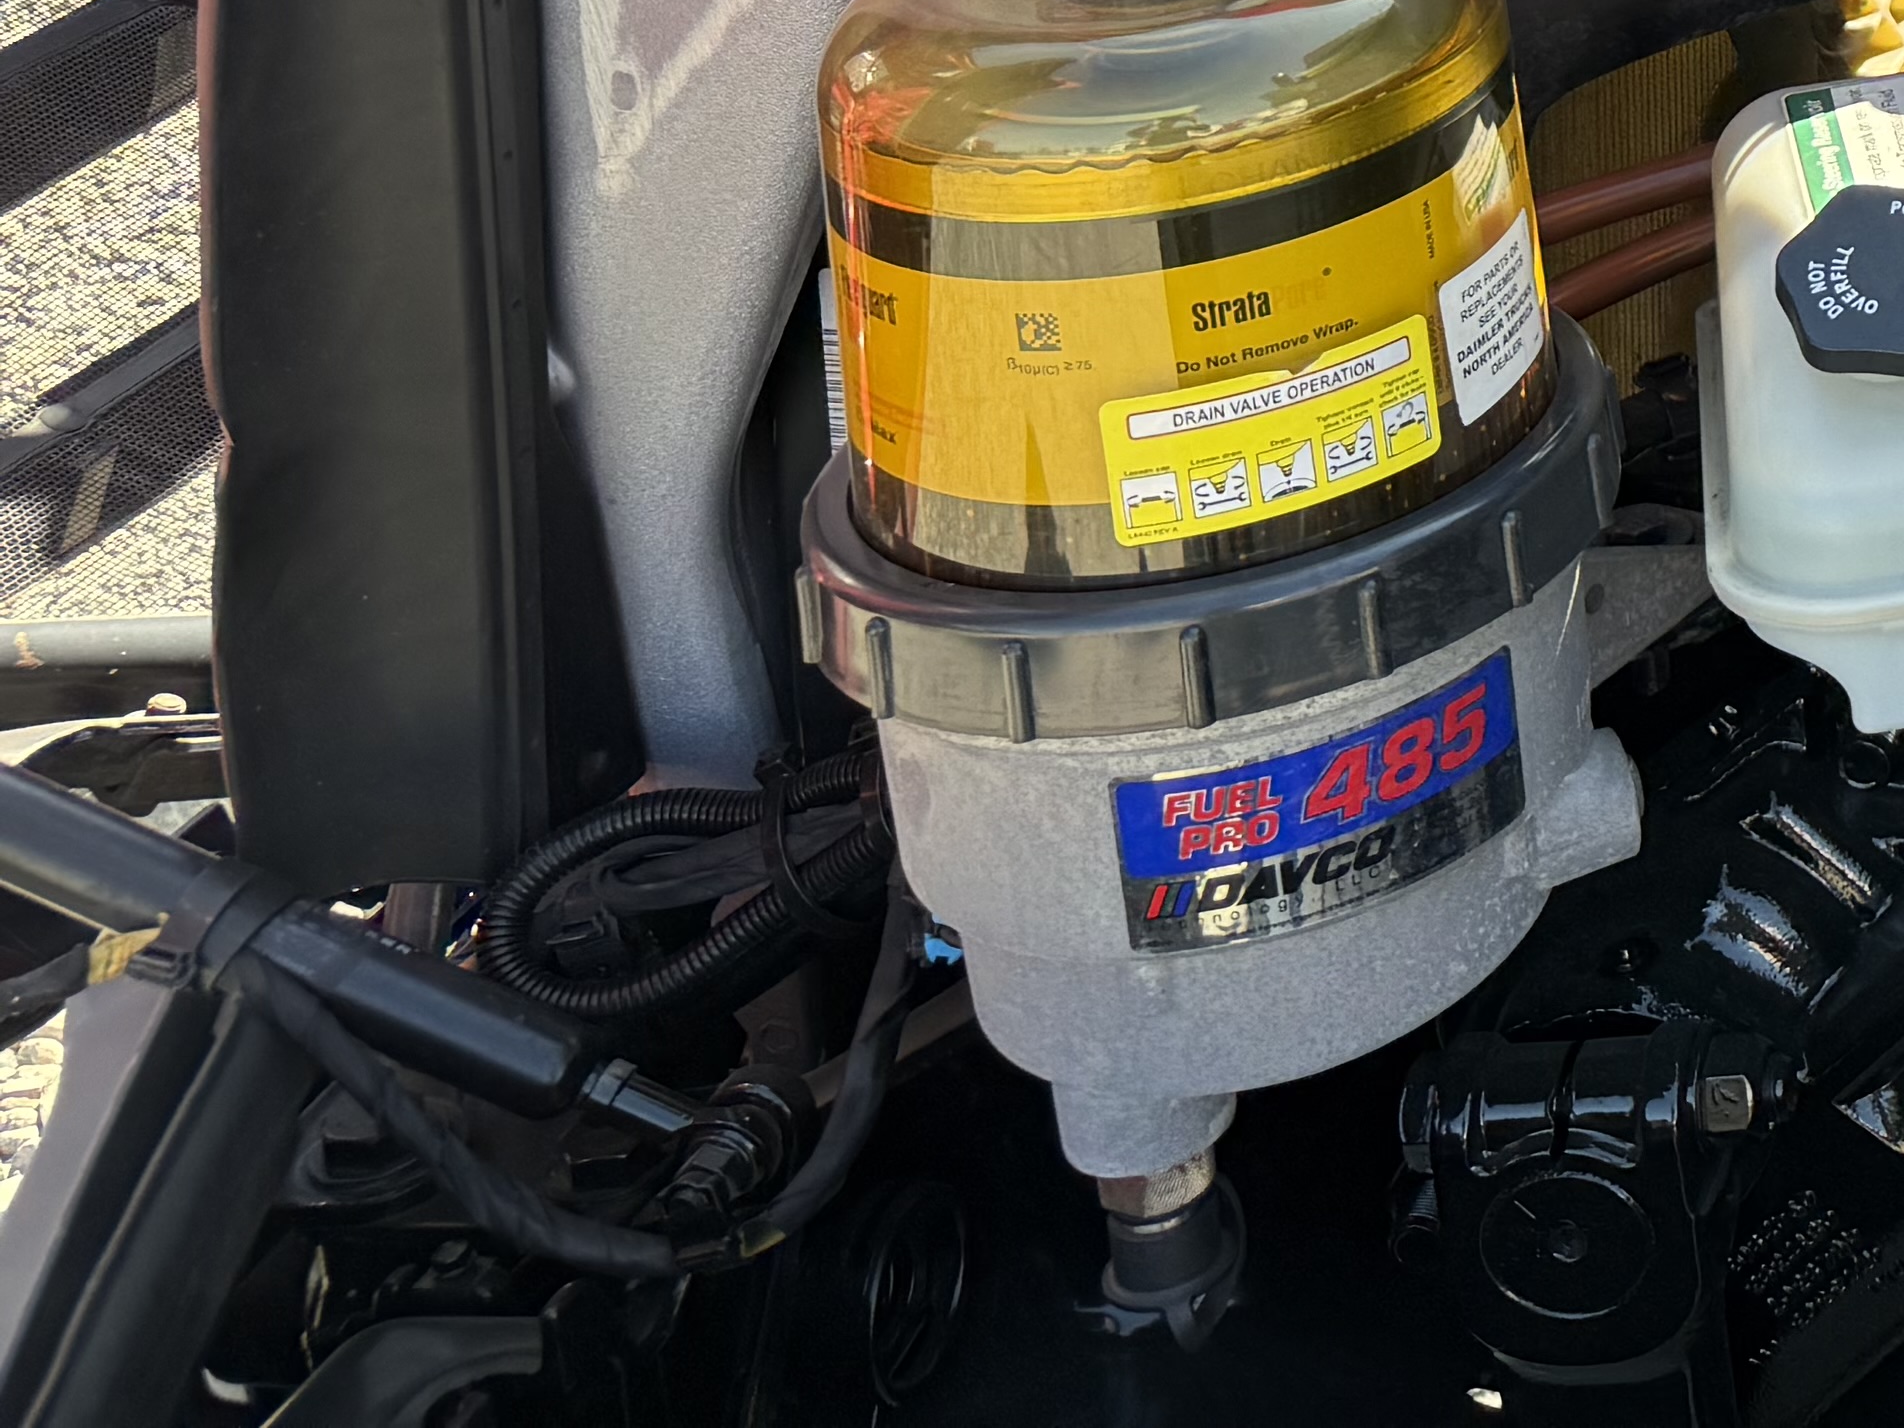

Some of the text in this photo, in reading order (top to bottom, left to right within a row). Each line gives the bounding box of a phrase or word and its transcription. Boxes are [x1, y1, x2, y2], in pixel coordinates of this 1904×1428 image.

[1816, 145, 1842, 191] Steering
[1460, 254, 1524, 323] REPLACEMENTS
[1461, 279, 1483, 304] FOR
[1484, 256, 1510, 286] PARTS
[1478, 282, 1519, 329] SEE YOUR
[1808, 260, 1844, 320] DO NOT
[1830, 245, 1879, 315] OVERFILL
[1176, 317, 1359, 374] Do Not Remove Wrap.
[1457, 318, 1505, 364] DAIMLER
[1505, 282, 1534, 327] TRUCKS
[1462, 342, 1501, 379] NORTH
[1503, 302, 1534, 348] AMERICA
[1491, 336, 1524, 376] DEALER
[1173, 357, 1375, 428] DRAIN VALVE OPERATION
[1303, 682, 1487, 825] 485
[1162, 776, 1283, 827] FUEL
[1179, 810, 1280, 861] PRO
[1198, 824, 1396, 915] DAVCO
